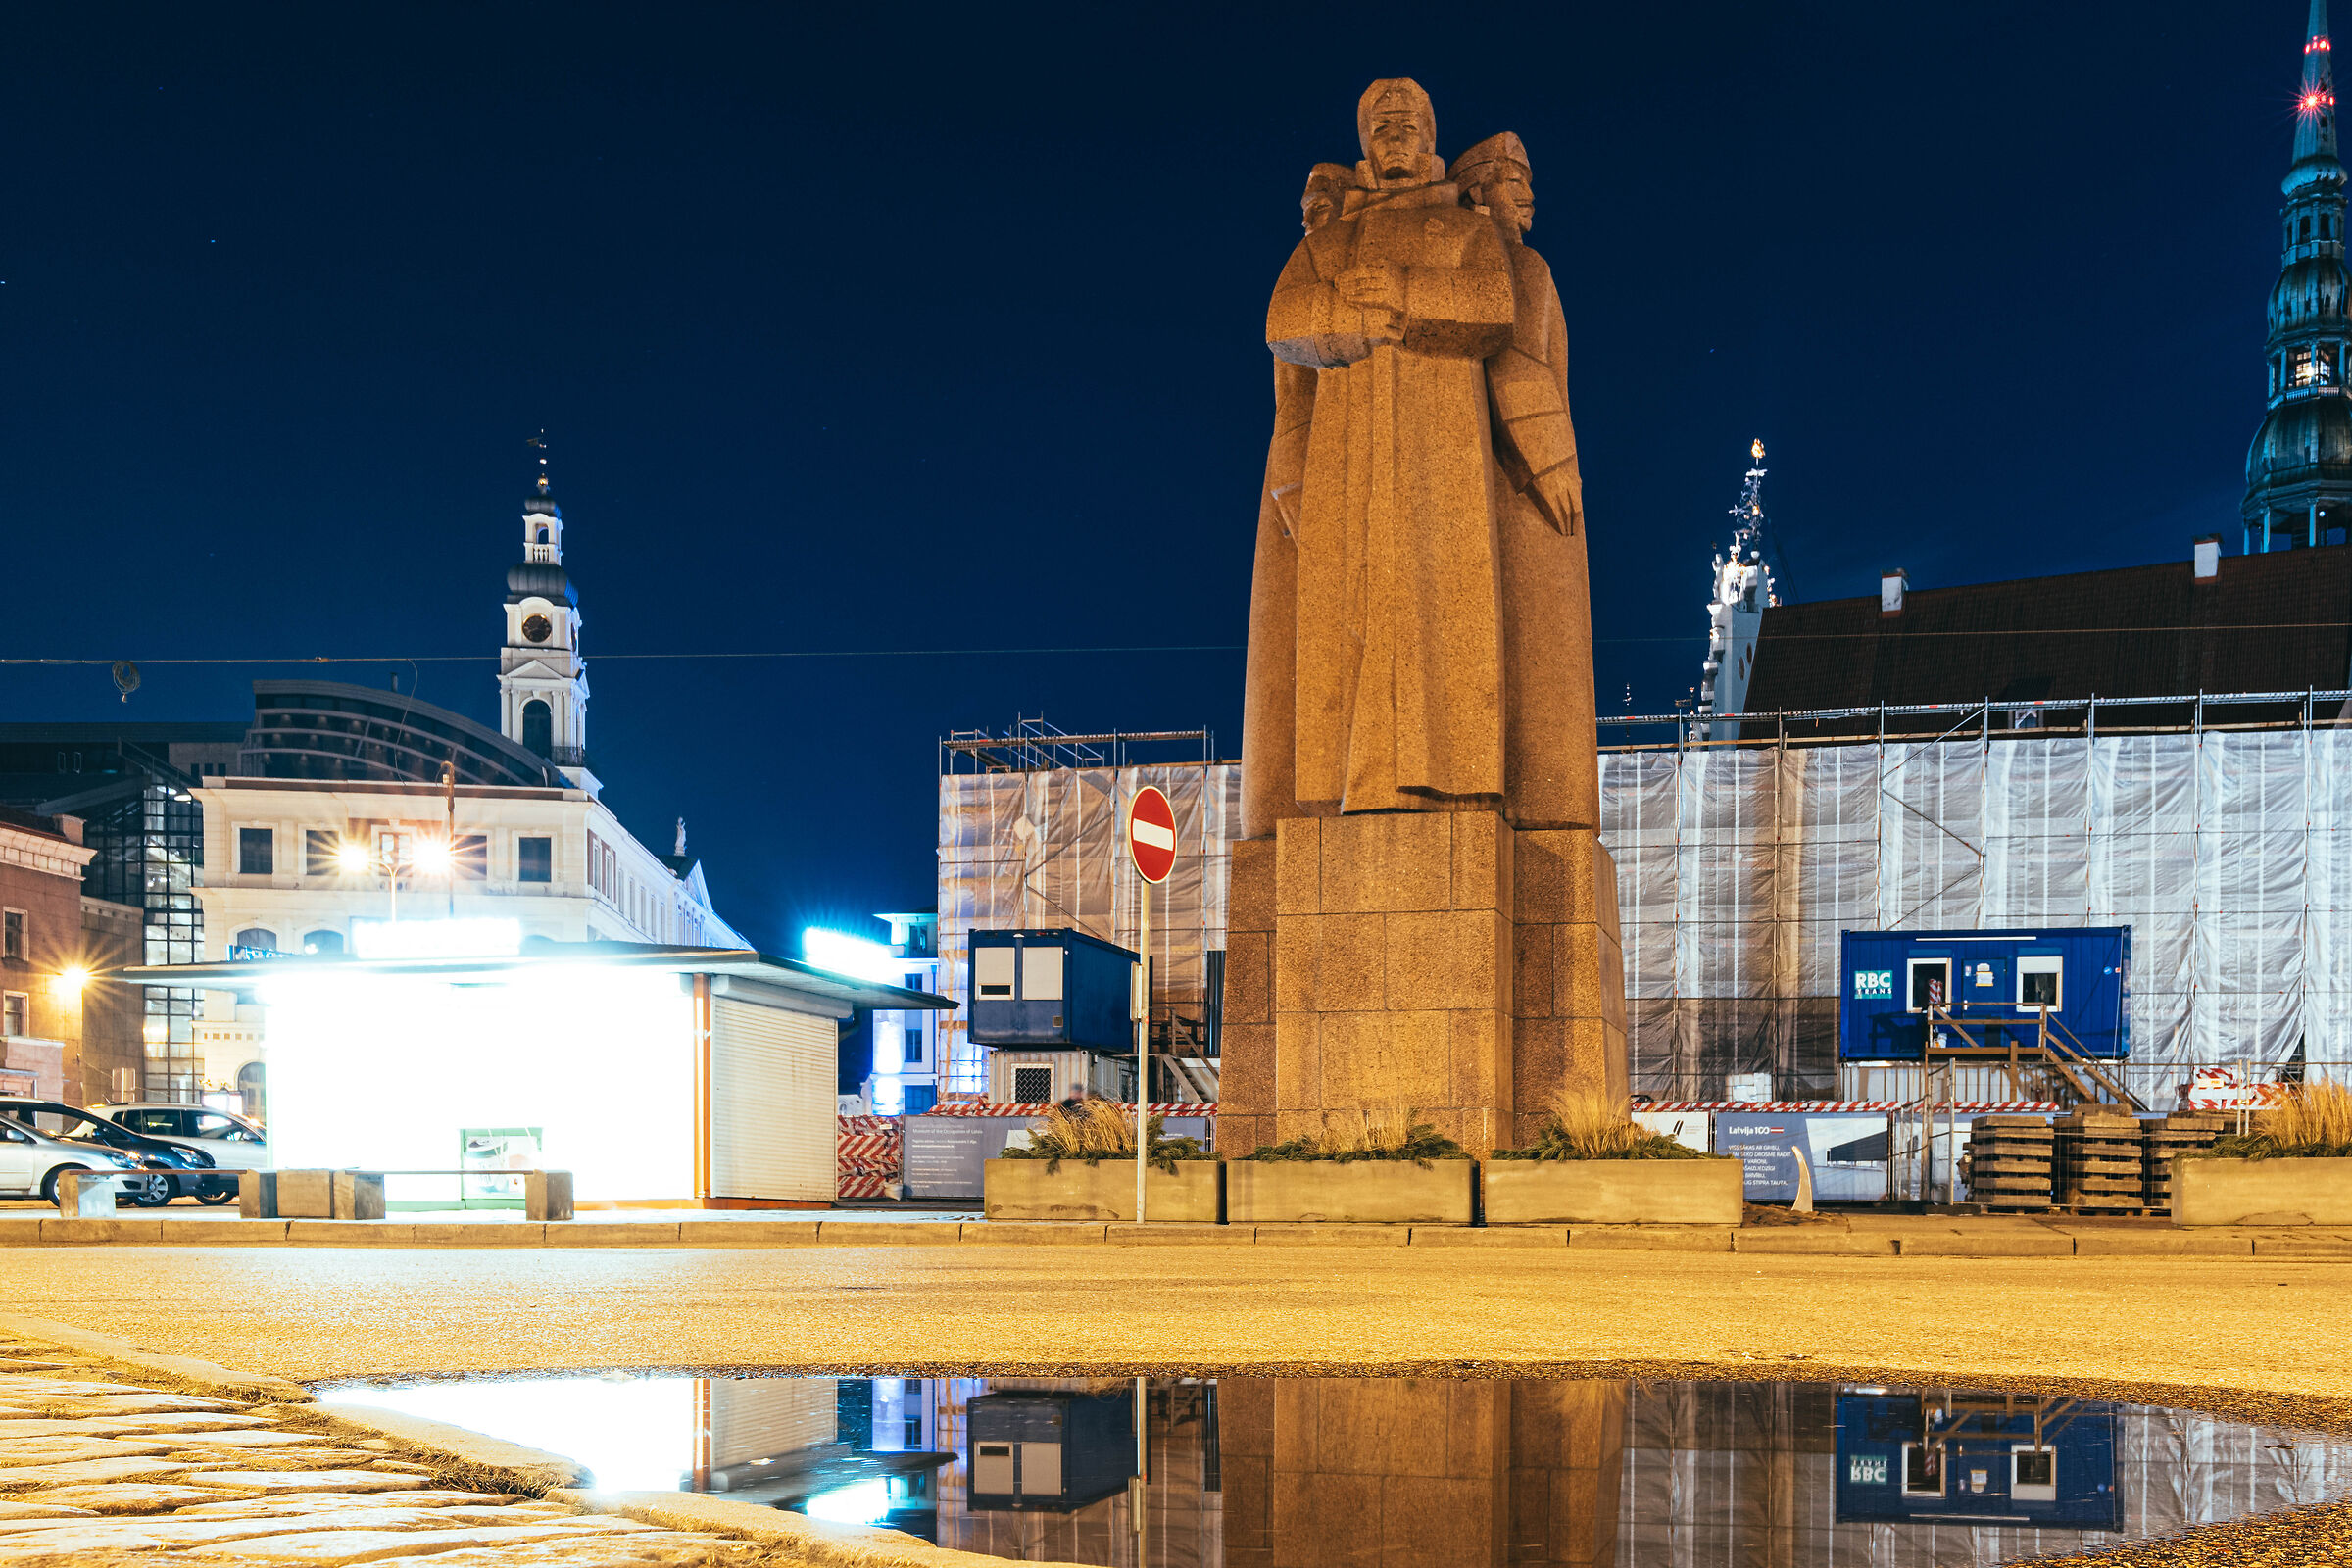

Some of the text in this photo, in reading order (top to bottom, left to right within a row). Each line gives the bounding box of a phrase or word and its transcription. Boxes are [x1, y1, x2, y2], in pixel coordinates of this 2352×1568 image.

[1855, 972, 1891, 988] RBC
[1729, 1126, 1769, 1136] Latvija 100
